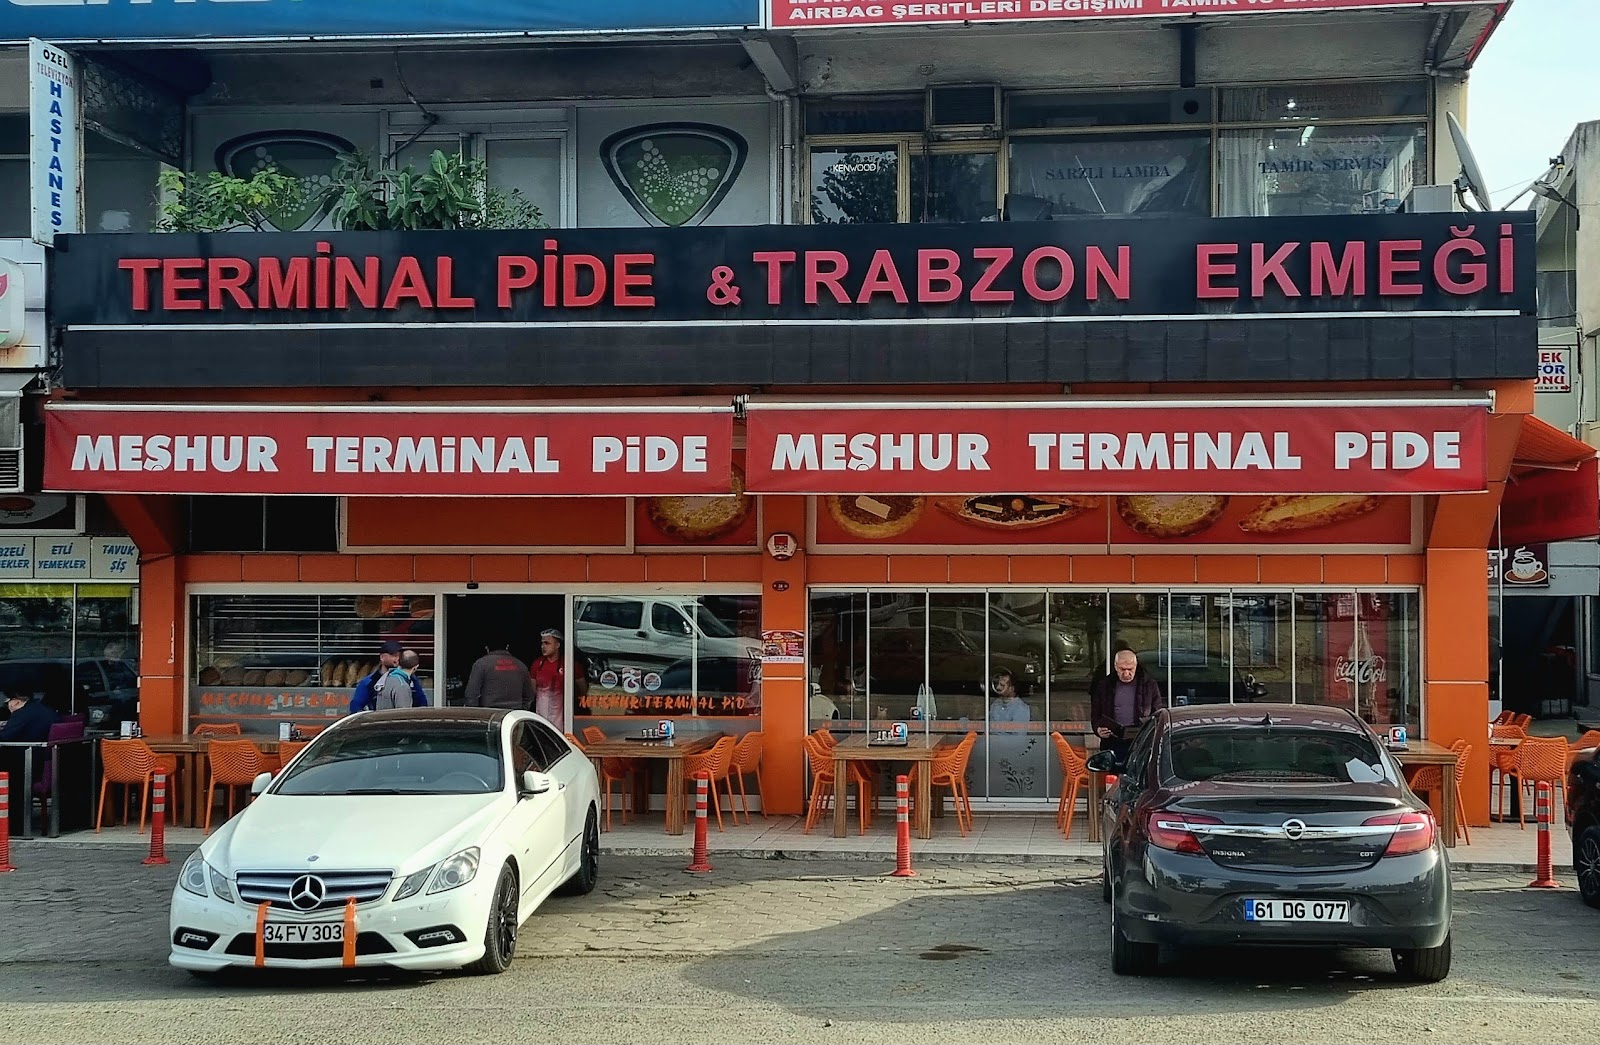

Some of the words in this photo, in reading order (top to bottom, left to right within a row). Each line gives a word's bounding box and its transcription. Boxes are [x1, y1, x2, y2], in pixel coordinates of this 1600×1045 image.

[43, 46, 68, 69] ÖZEL
[49, 80, 63, 232] HASTANES
[832, 163, 876, 172] KENWOOD
[1112, 165, 1171, 179] LAMBA
[119, 242, 475, 311] TERMİNAL
[497, 239, 655, 308] PİDE
[707, 267, 740, 306] &
[753, 247, 1131, 305] TRABZON
[1196, 224, 1514, 299] EKMEĞİ
[1537, 352, 1563, 363] EK
[72, 435, 279, 473] MEŞHUR
[772, 433, 991, 471] MEŞHUR
[51, 542, 73, 555] ETLİ
[102, 545, 136, 556] TAVUK
[38, 560, 86, 570] YEMEKLER
[110, 557, 127, 573] ŞİŞ
[1255, 902, 1273, 919] 61
[1283, 902, 1306, 919] DG
[1313, 903, 1347, 920] 077
[265, 925, 284, 941] 34
[286, 925, 308, 941] FV
[312, 924, 345, 941] 303
